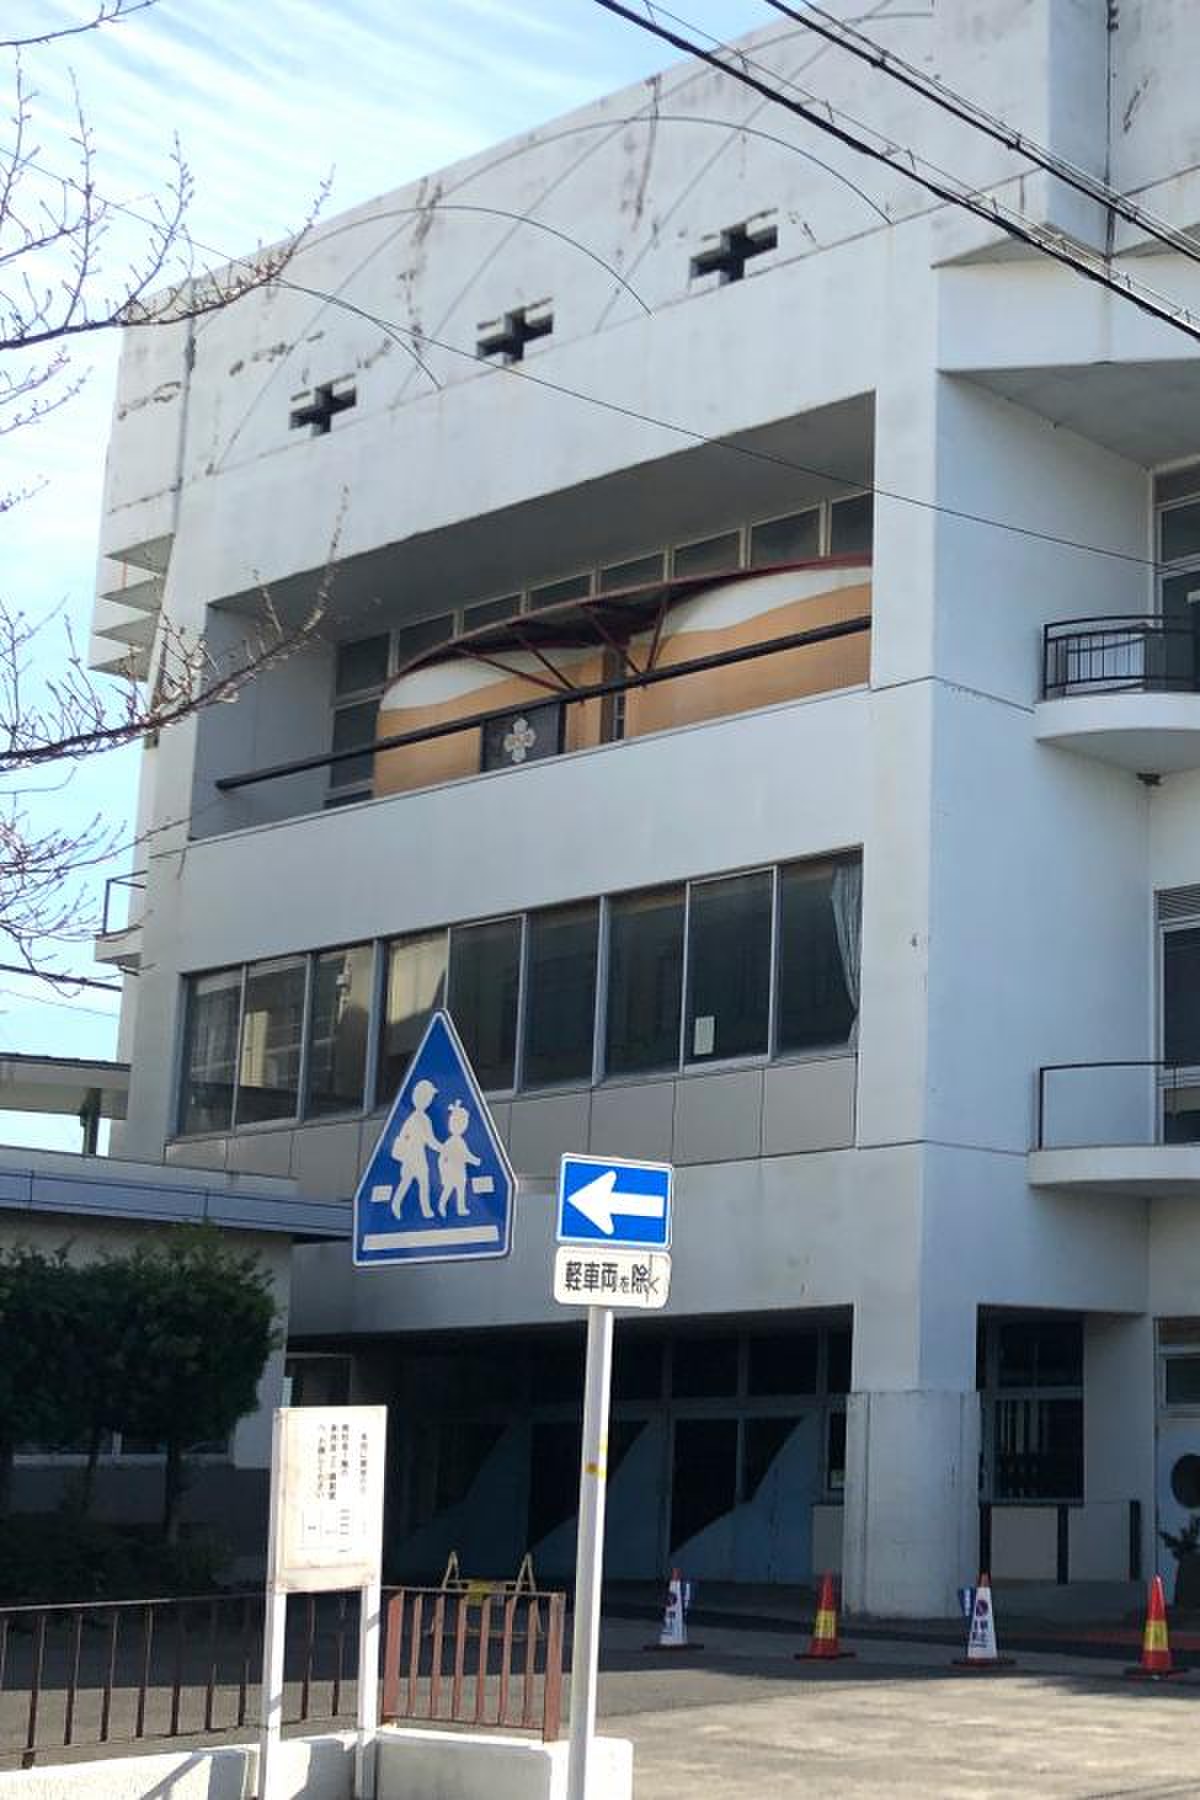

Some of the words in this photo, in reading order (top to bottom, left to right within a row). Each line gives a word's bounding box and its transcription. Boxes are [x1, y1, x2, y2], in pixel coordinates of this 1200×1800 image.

[565, 1260, 660, 1294] 軽車両を除く
